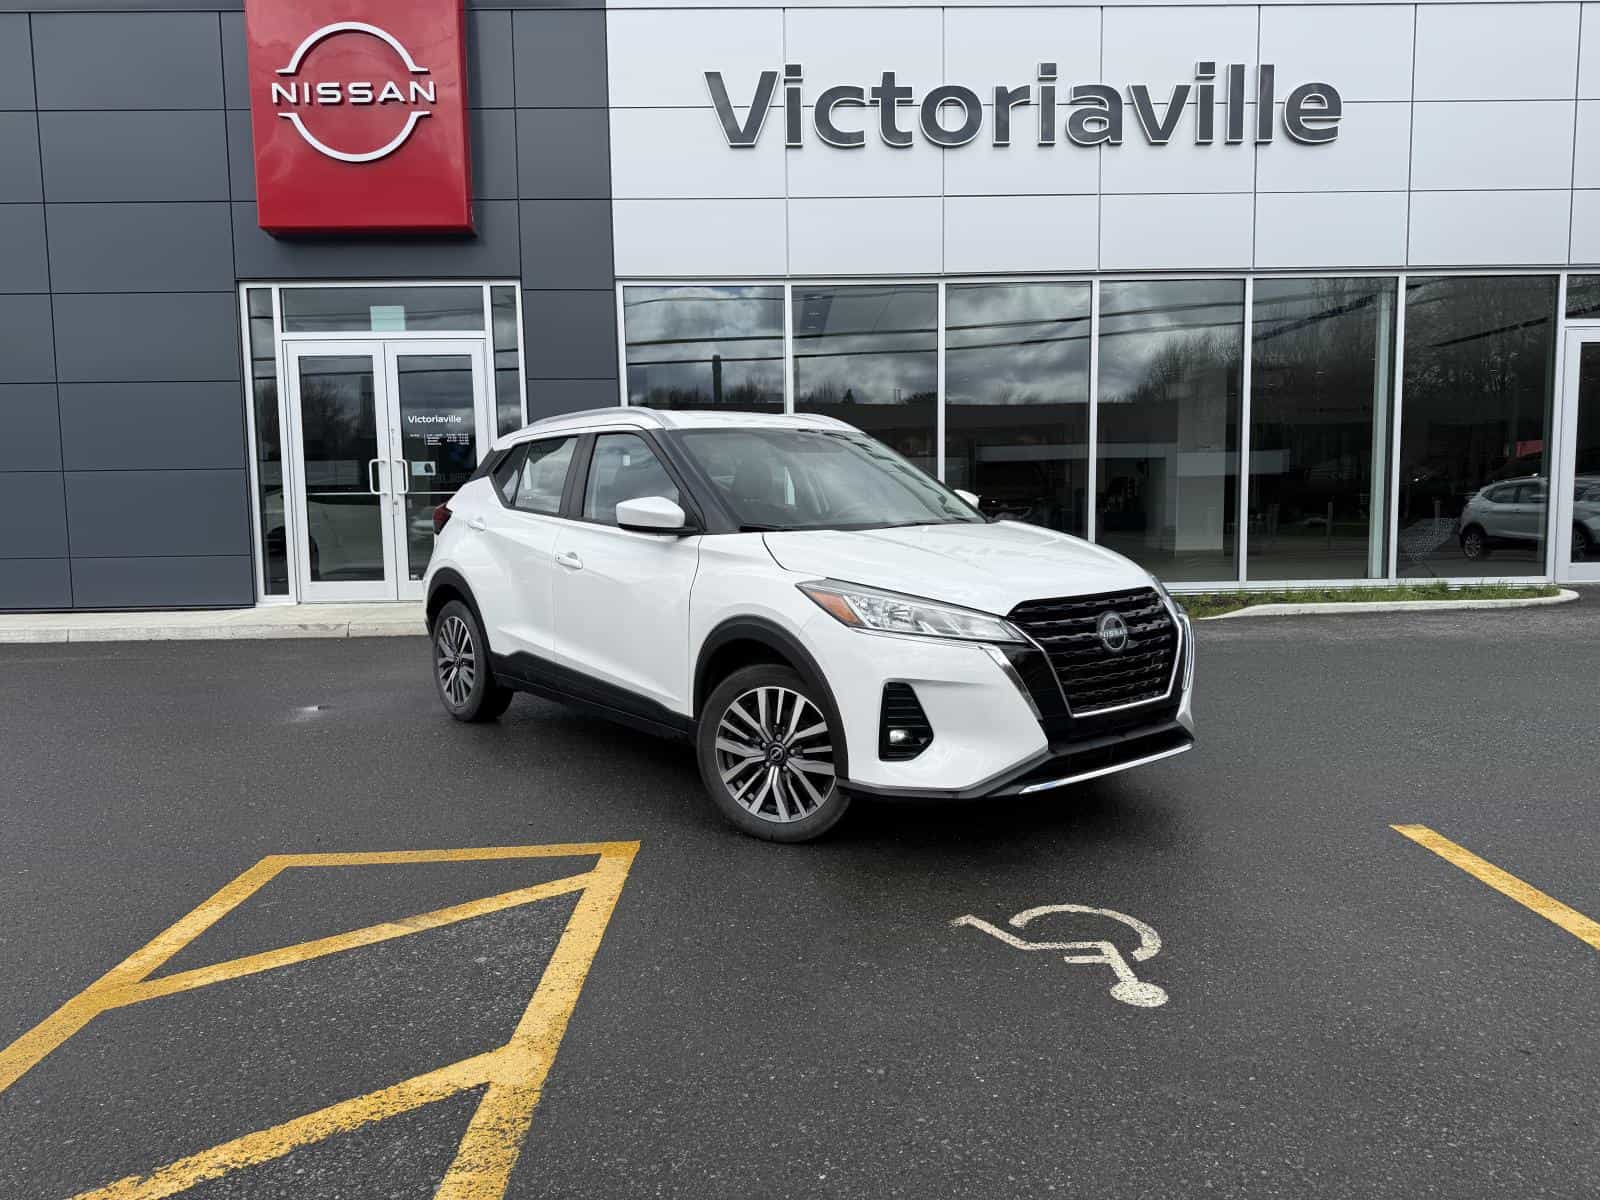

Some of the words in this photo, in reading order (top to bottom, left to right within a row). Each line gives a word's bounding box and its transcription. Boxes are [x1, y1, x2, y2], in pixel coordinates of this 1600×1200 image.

[271, 80, 437, 104] NISSAN
[703, 62, 1342, 148] Victoriaville
[407, 415, 462, 424] Victoriaville
